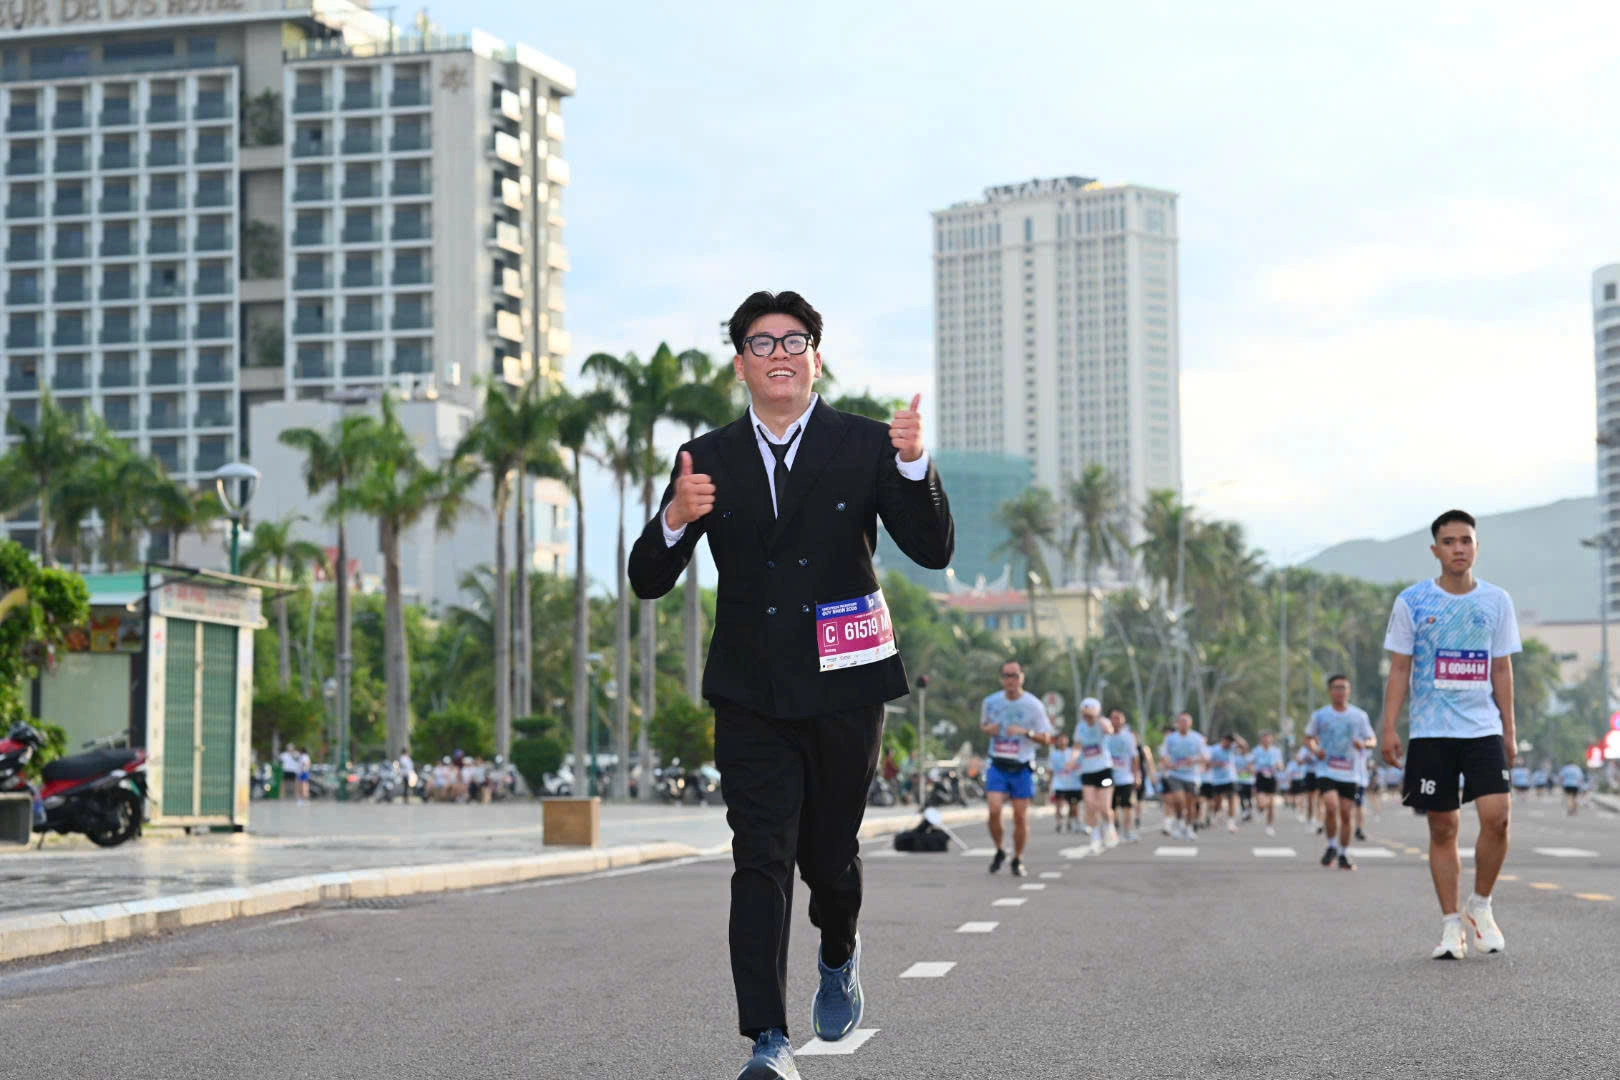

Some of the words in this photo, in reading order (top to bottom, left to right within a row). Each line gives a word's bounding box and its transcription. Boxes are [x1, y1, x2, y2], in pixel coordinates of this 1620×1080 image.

[825, 625, 836, 643] C
[844, 617, 878, 640] 61519
[1420, 778, 1436, 795] 16
